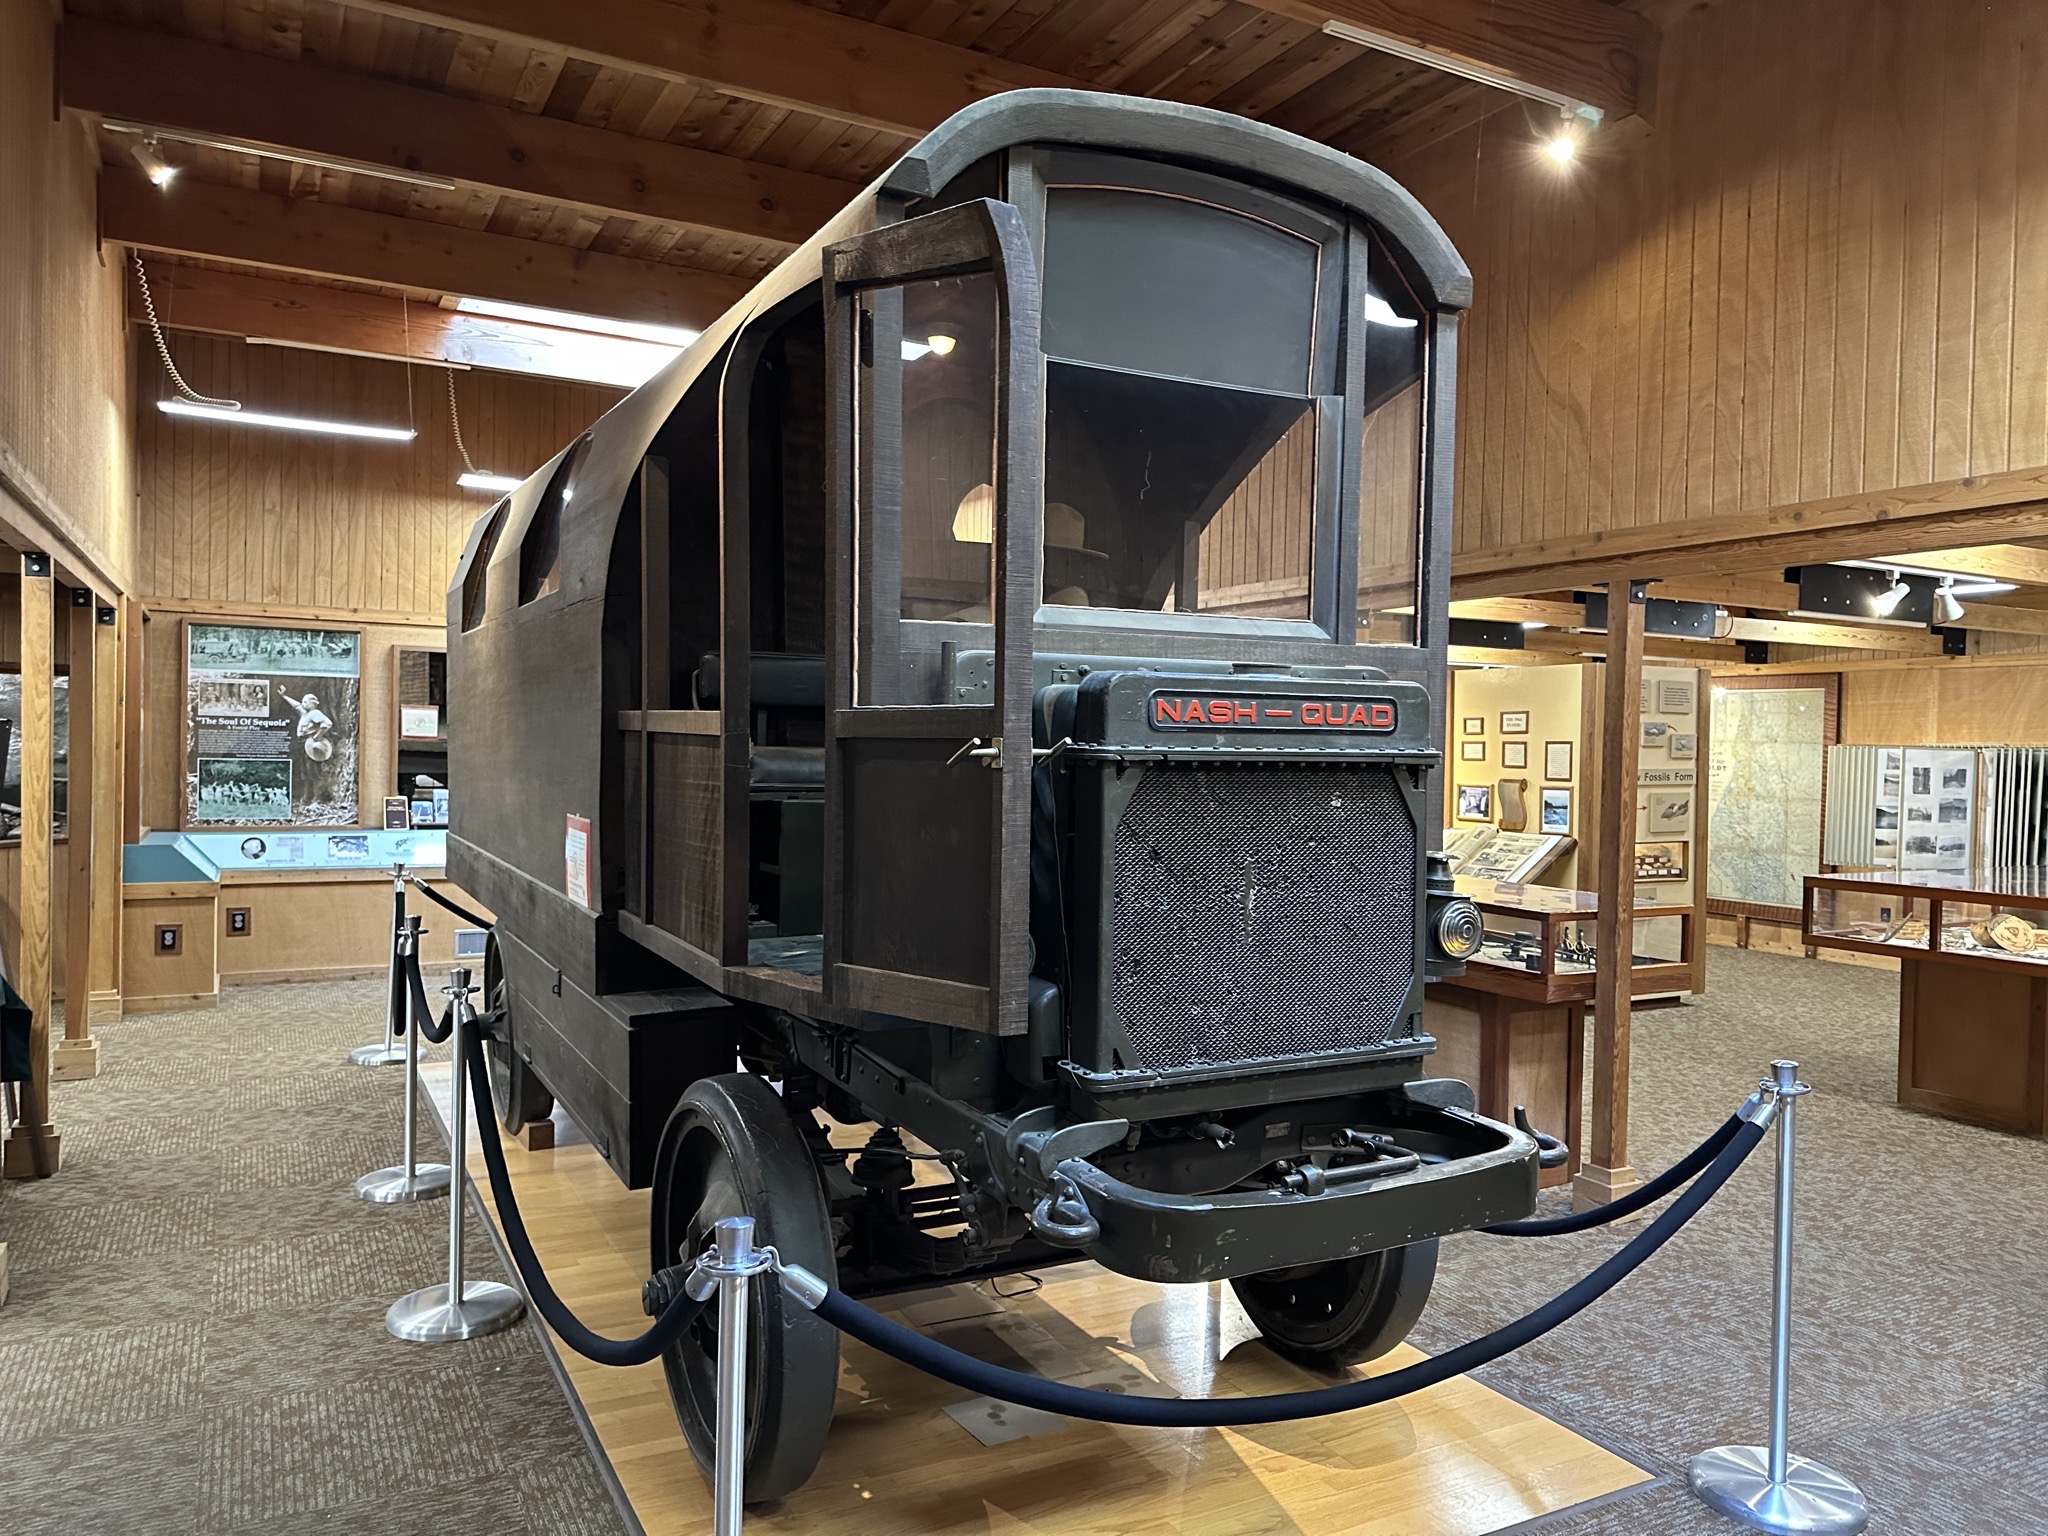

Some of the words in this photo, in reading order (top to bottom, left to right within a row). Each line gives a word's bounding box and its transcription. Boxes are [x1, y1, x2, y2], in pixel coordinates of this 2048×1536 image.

[1156, 698, 1257, 723] NASH
[1301, 703, 1393, 726] QUAD
[1644, 772, 1671, 782] Fossils
[1674, 772, 1694, 782] Form
